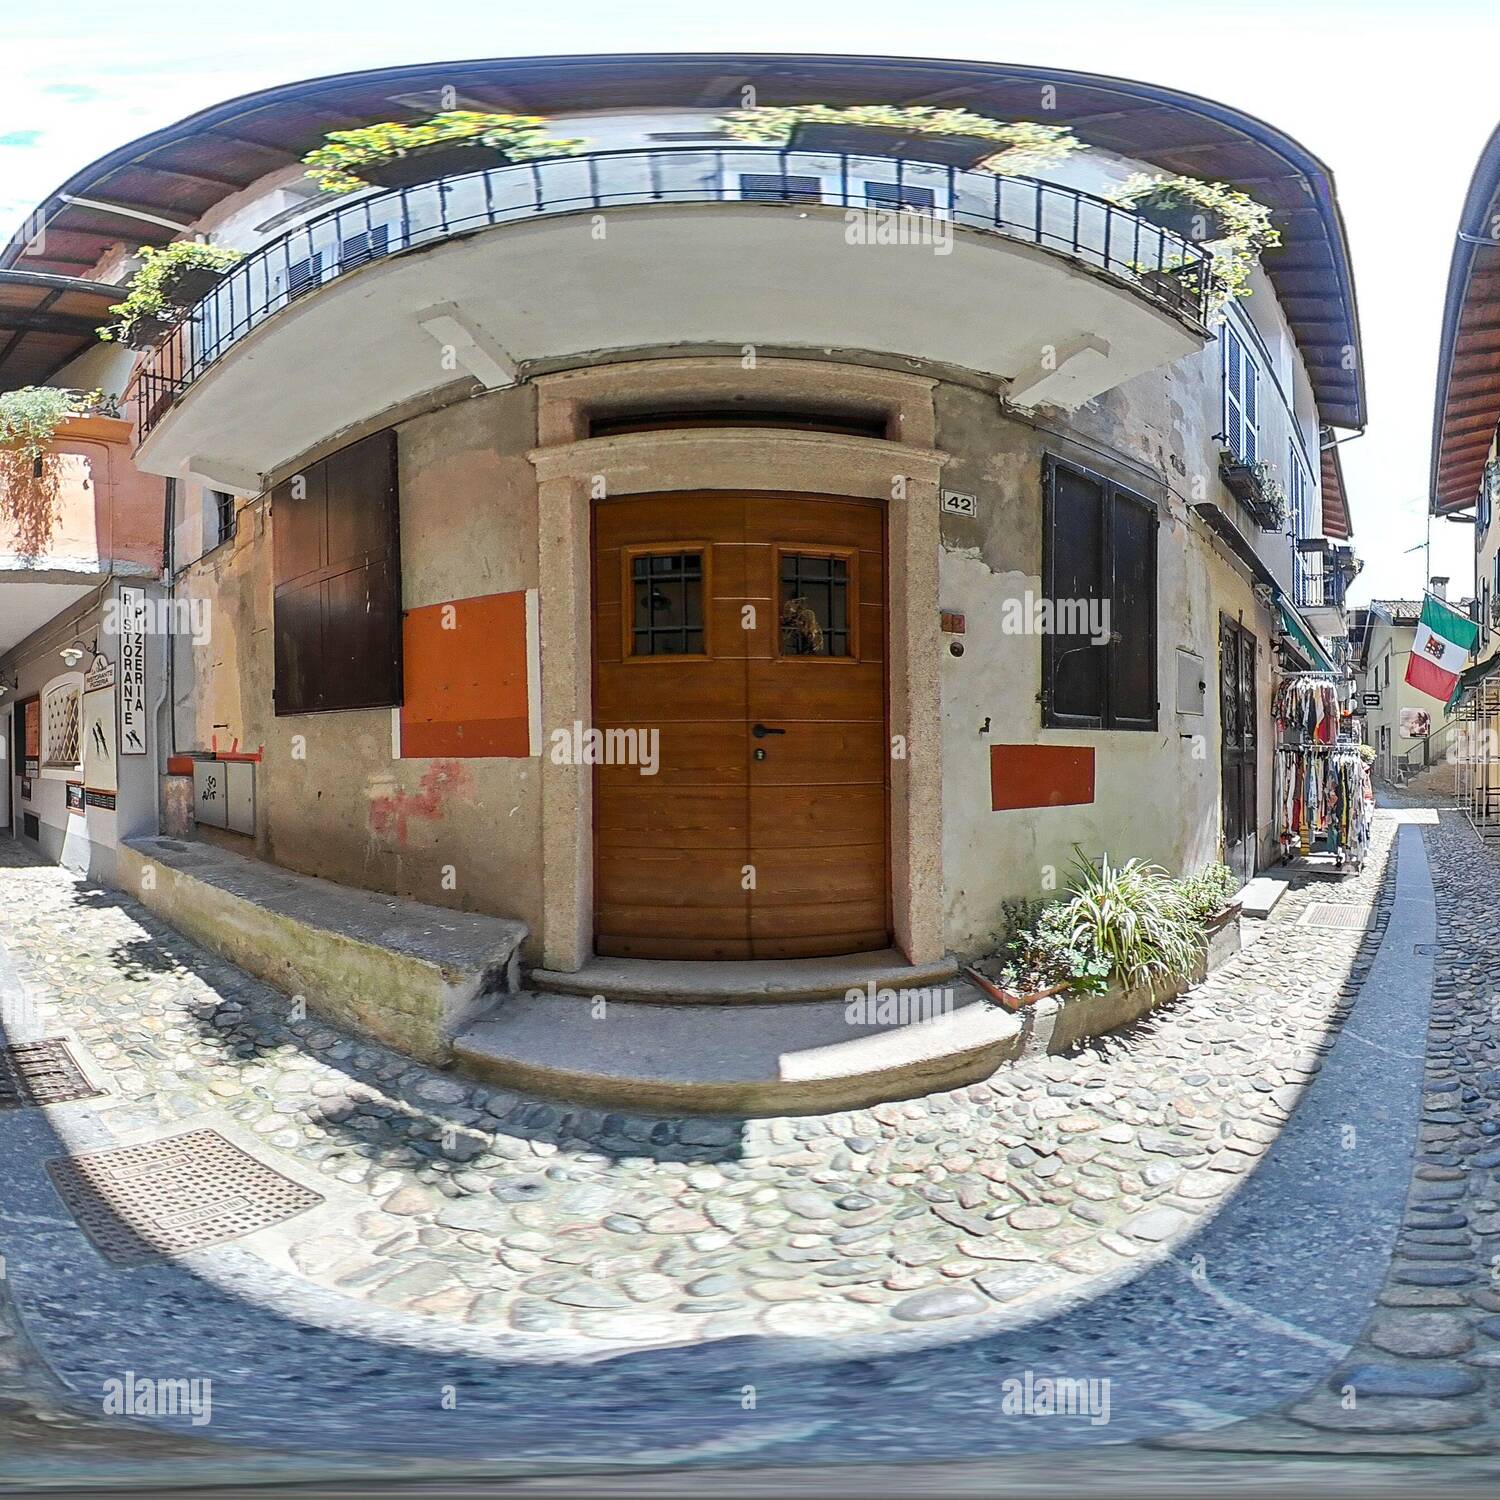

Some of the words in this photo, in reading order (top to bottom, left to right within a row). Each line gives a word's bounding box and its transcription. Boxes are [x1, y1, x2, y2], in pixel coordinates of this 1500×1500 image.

[947, 497, 971, 511] 42
[123, 593, 133, 725] RISTORANTE
[134, 607, 143, 712] PIZZERIA
